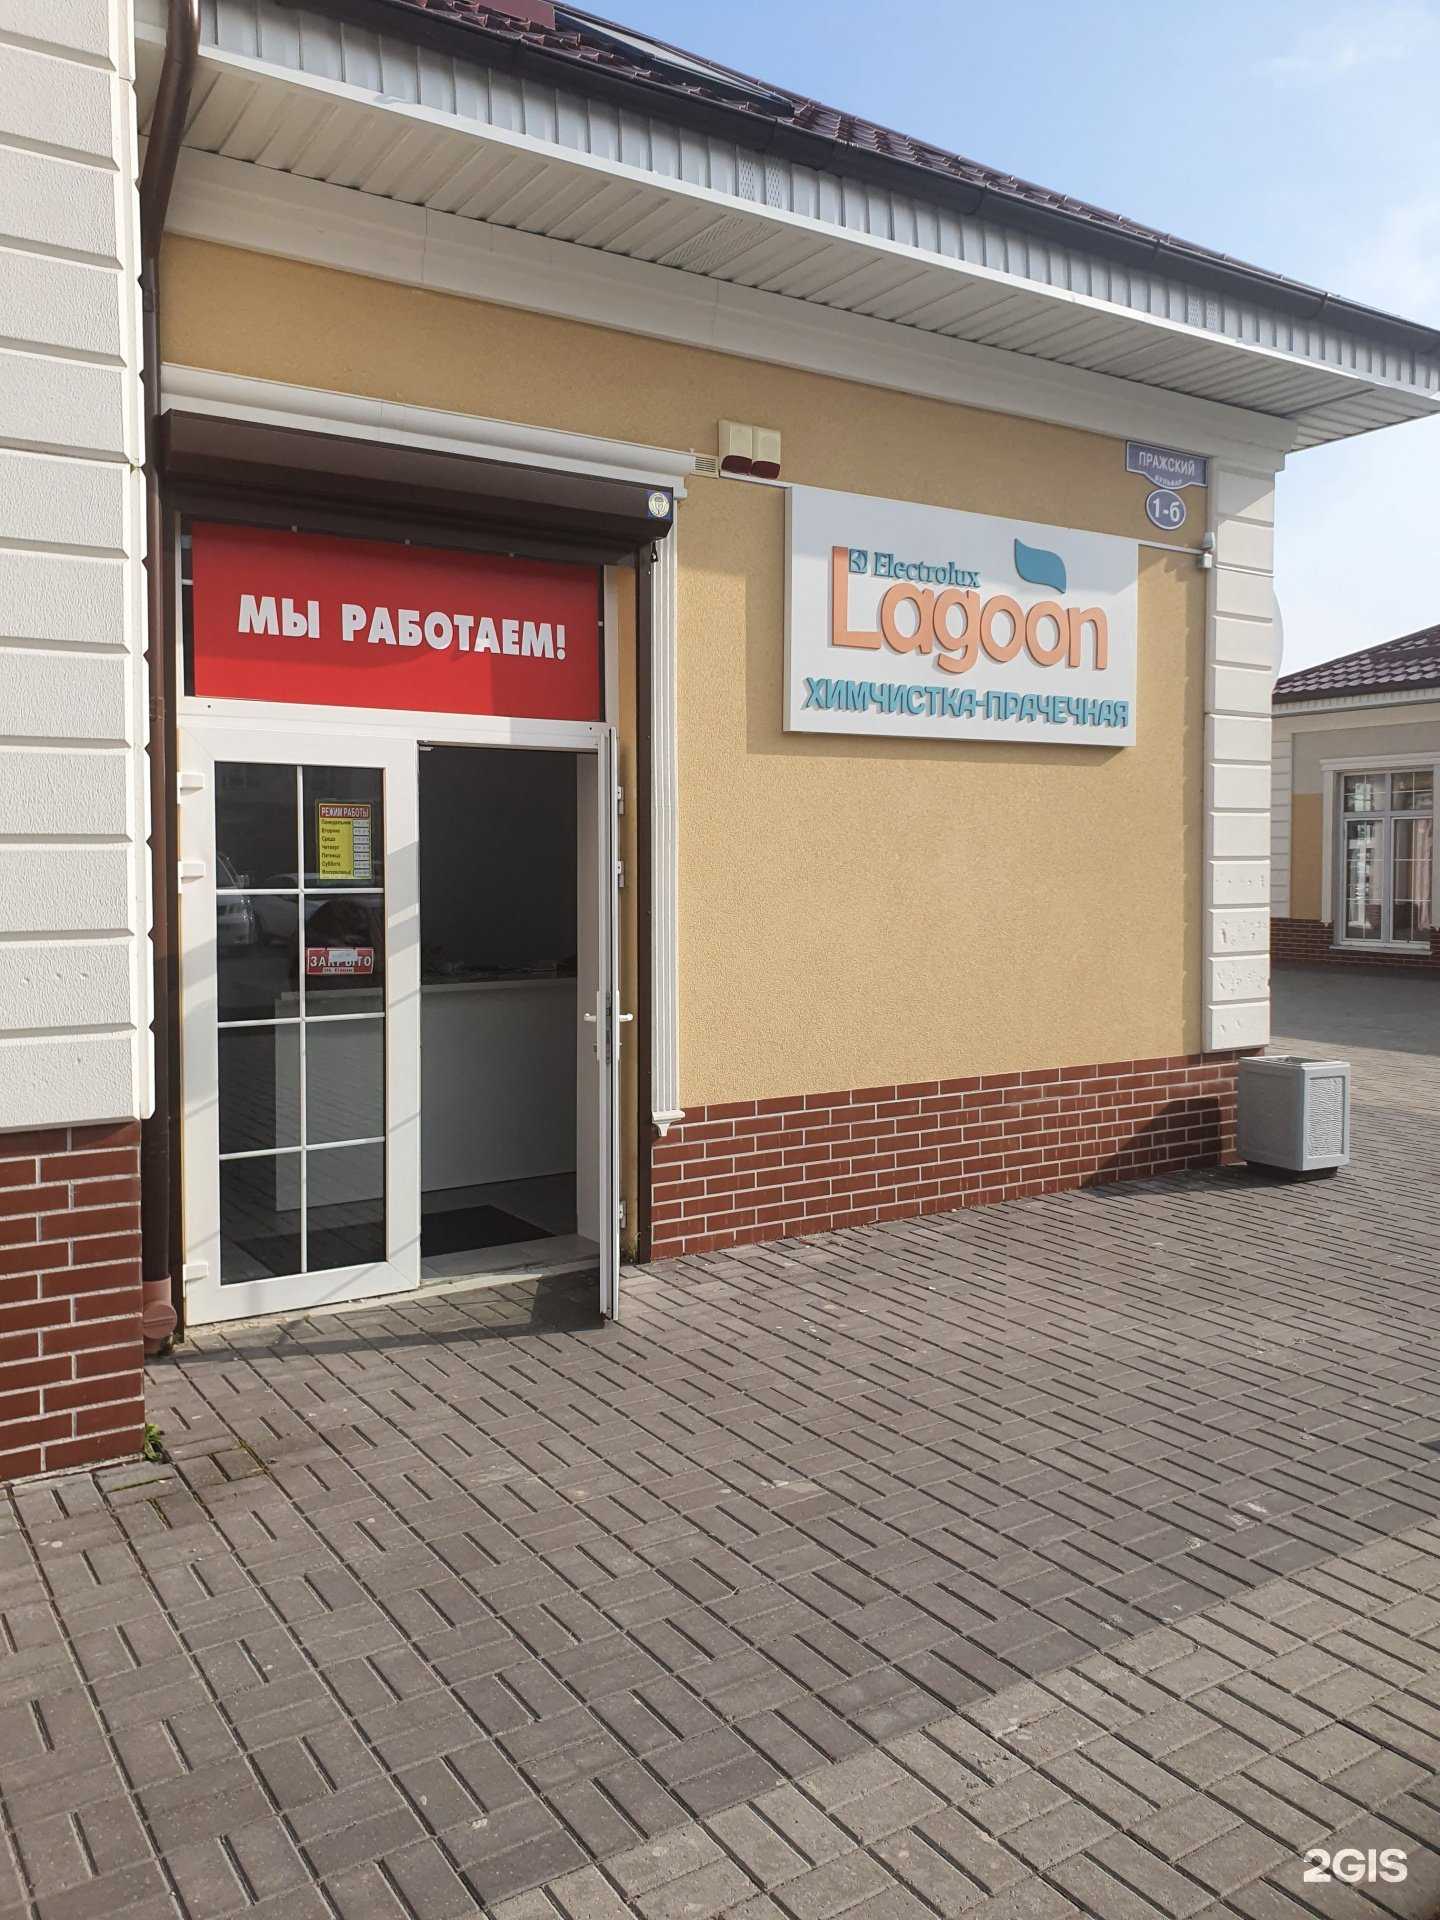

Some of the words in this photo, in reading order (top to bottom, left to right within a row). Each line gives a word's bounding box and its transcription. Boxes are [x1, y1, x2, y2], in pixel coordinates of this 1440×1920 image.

[1139, 451, 1195, 475] ПРАЖСКИЙ
[874, 551, 981, 588] Electrolux
[238, 594, 321, 639] МЫ
[342, 603, 567, 661] РАБОТАЕМ!
[831, 546, 1109, 674] Lagoon
[803, 676, 1130, 729] ХИМЧИСТКА-ПРАЧЕЧНАЯ
[321, 807, 343, 817] РЕЖИМ
[344, 807, 369, 818] РАБОТЫ
